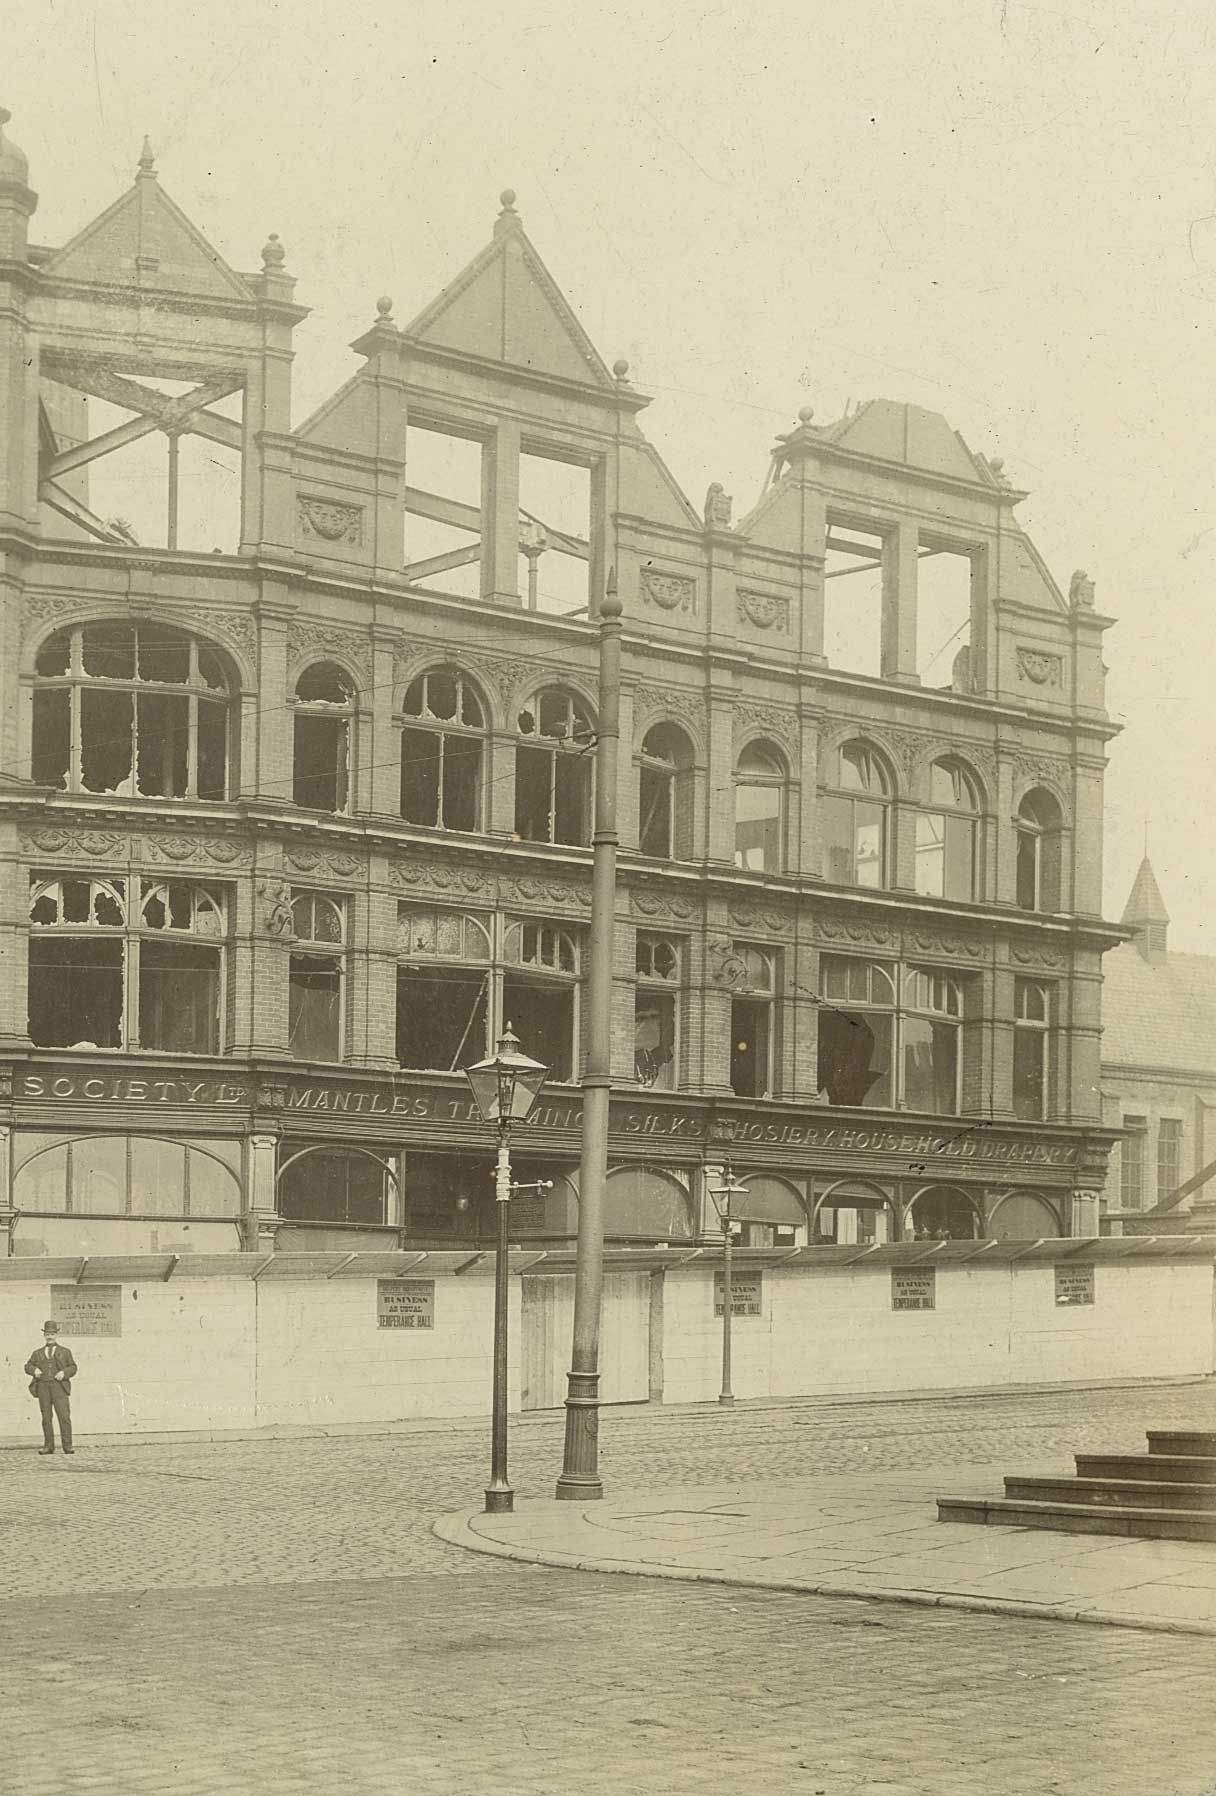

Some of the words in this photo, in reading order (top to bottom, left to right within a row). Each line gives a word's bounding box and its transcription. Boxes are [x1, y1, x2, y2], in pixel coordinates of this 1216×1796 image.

[24, 1076, 205, 1102] SOCIETY
[287, 1087, 428, 1116] MANTLES
[625, 1113, 703, 1136] SILKS
[733, 1121, 835, 1147] HOSIERY
[839, 1130, 977, 1157] HOUSEHOLD
[384, 1296, 428, 1304] BUSINESS
[379, 1314, 415, 1327] TEMPERANCE
[417, 1314, 432, 1327] HALL
